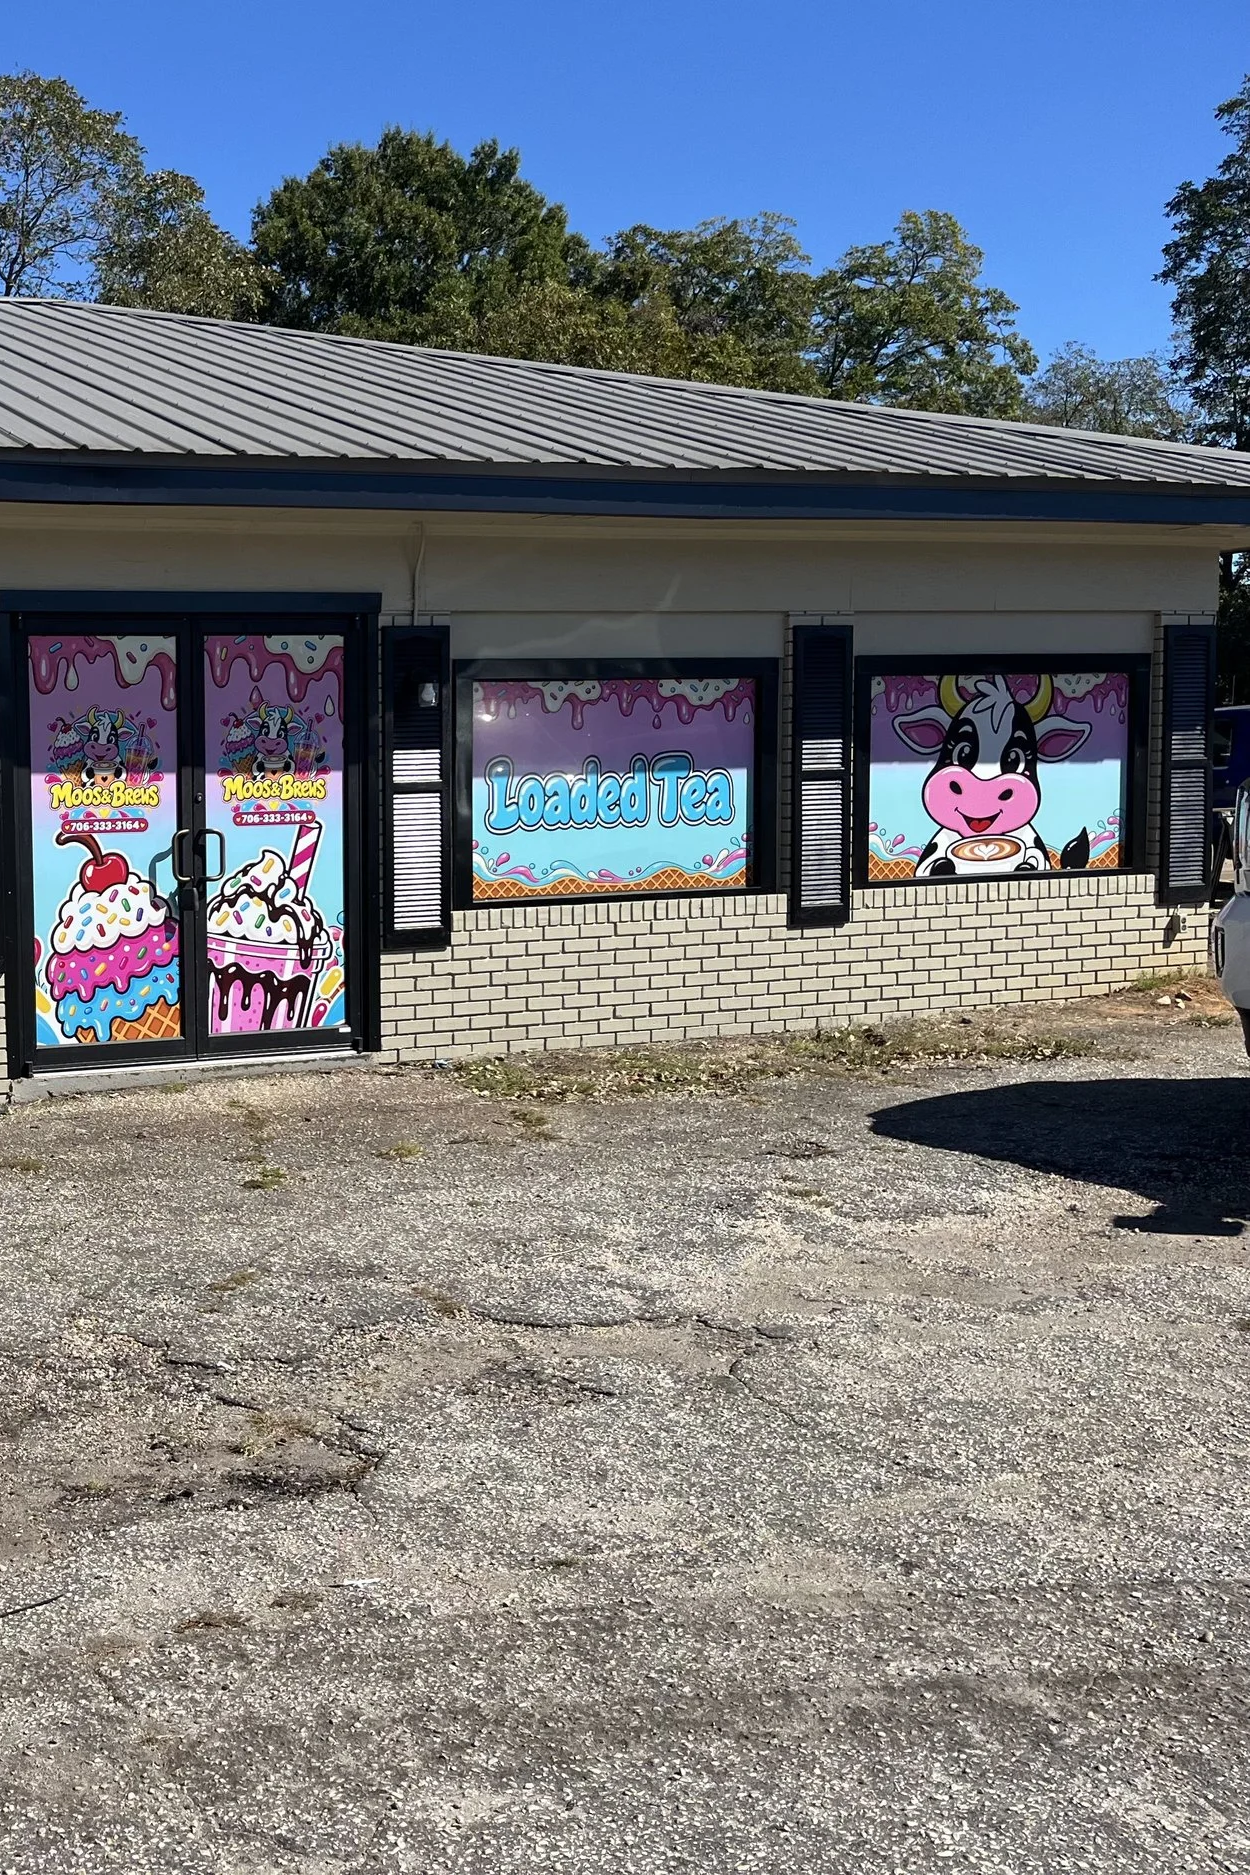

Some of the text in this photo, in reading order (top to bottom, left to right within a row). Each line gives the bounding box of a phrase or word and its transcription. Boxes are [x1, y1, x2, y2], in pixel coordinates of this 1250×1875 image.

[487, 754, 734, 832] Loaded Tea
[241, 812, 308, 824] 706-333-3164
[70, 820, 140, 832] 706-333-3164
